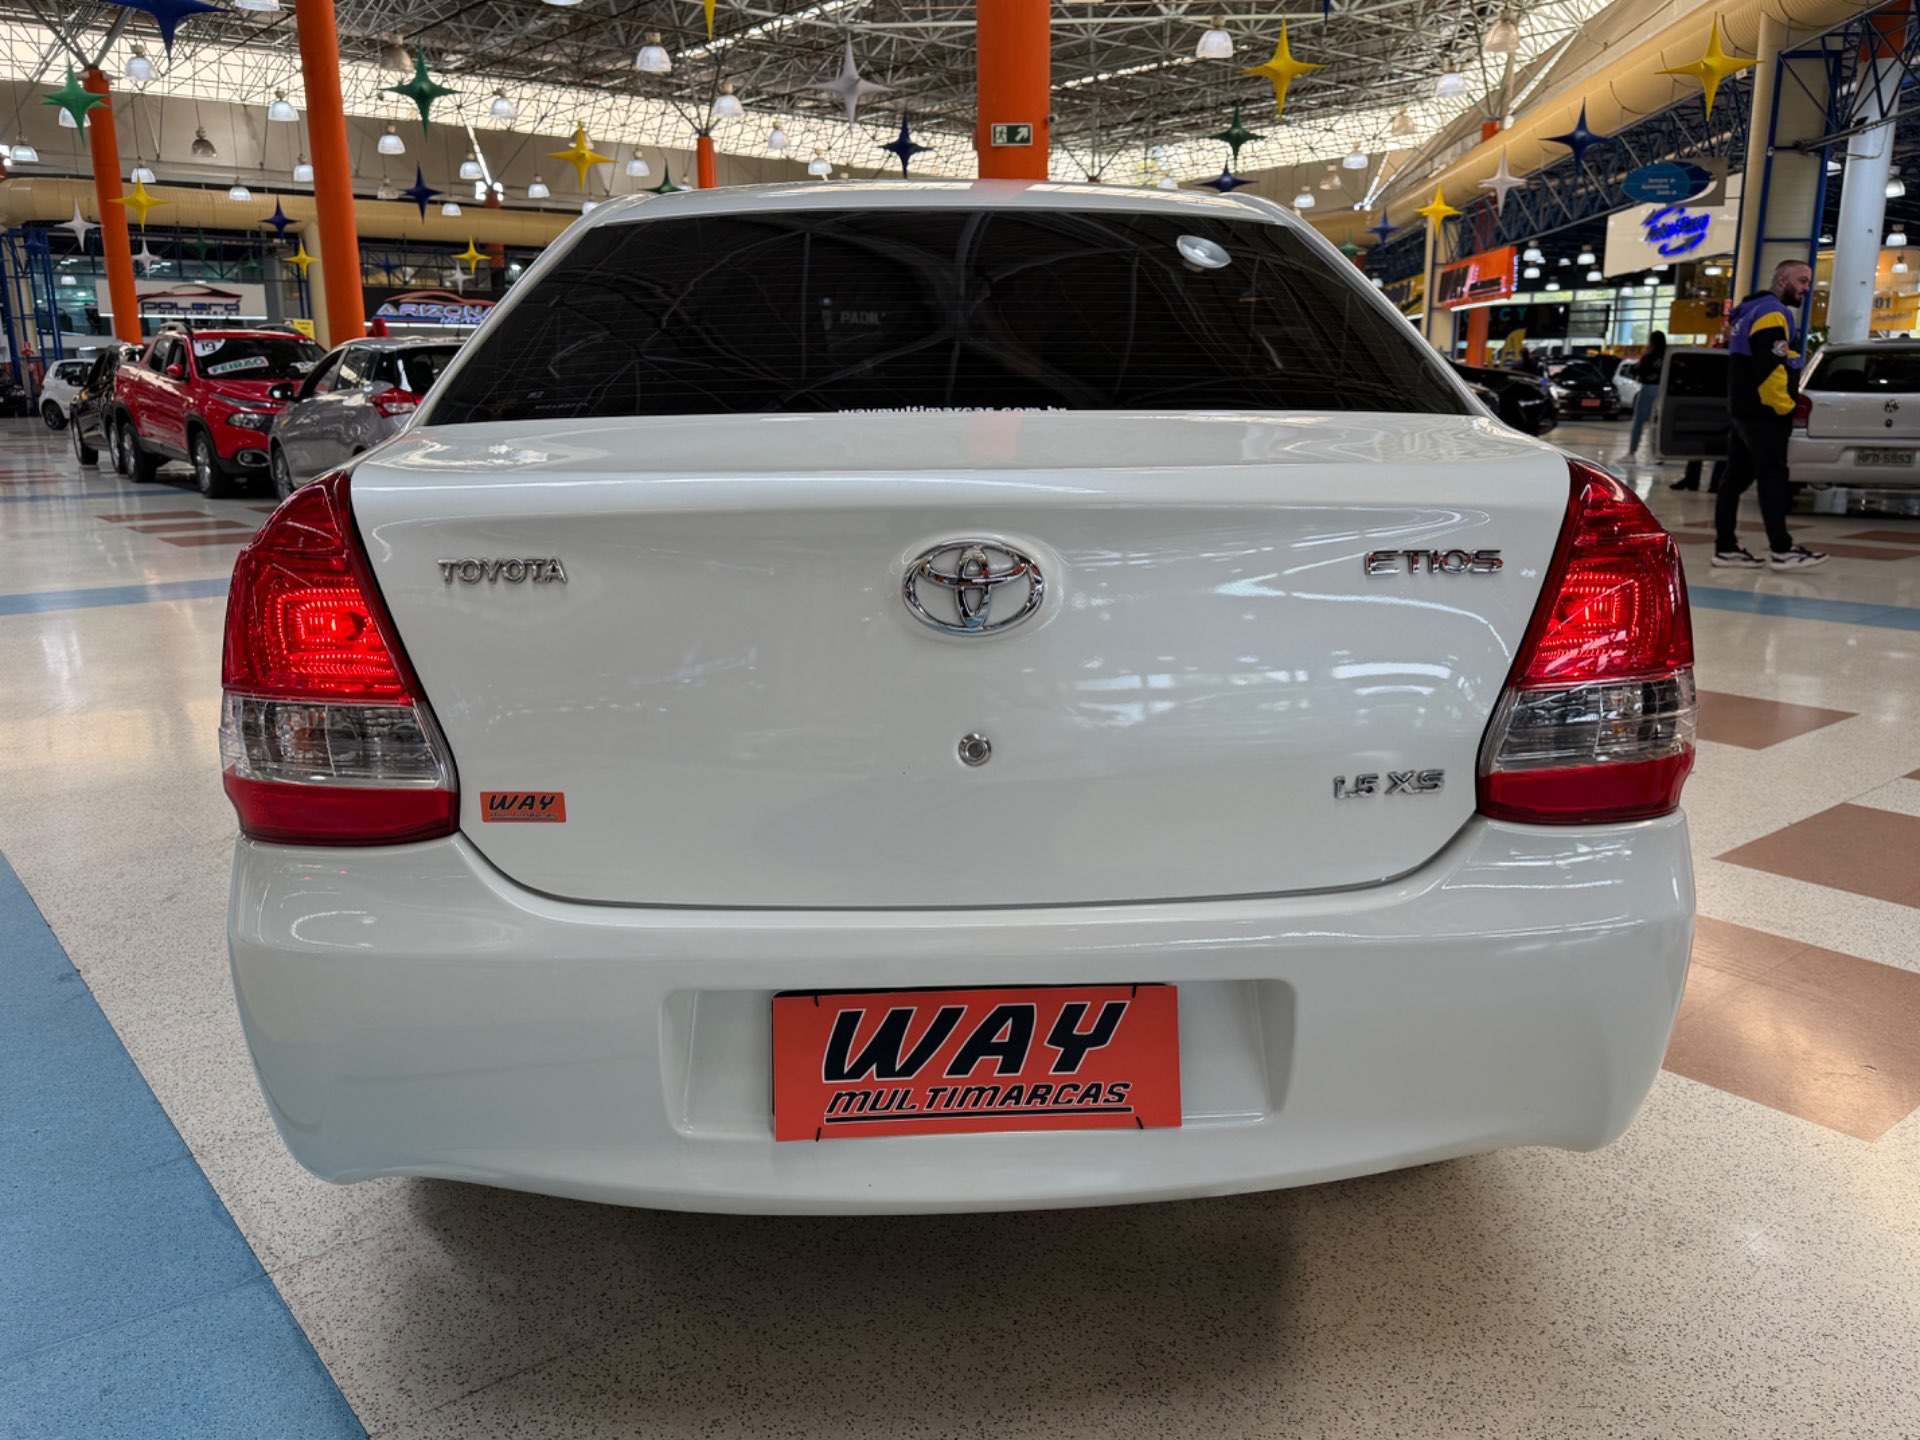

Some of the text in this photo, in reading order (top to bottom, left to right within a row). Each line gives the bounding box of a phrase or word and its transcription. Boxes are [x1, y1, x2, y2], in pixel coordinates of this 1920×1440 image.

[438, 558, 567, 584] TOYOTA
[1365, 550, 1504, 575] ETIOS
[1384, 769, 1446, 795] XS
[489, 795, 555, 810] WAY
[822, 1001, 1130, 1083] WAY
[825, 1082, 1132, 1116] MULTIMARCAS
